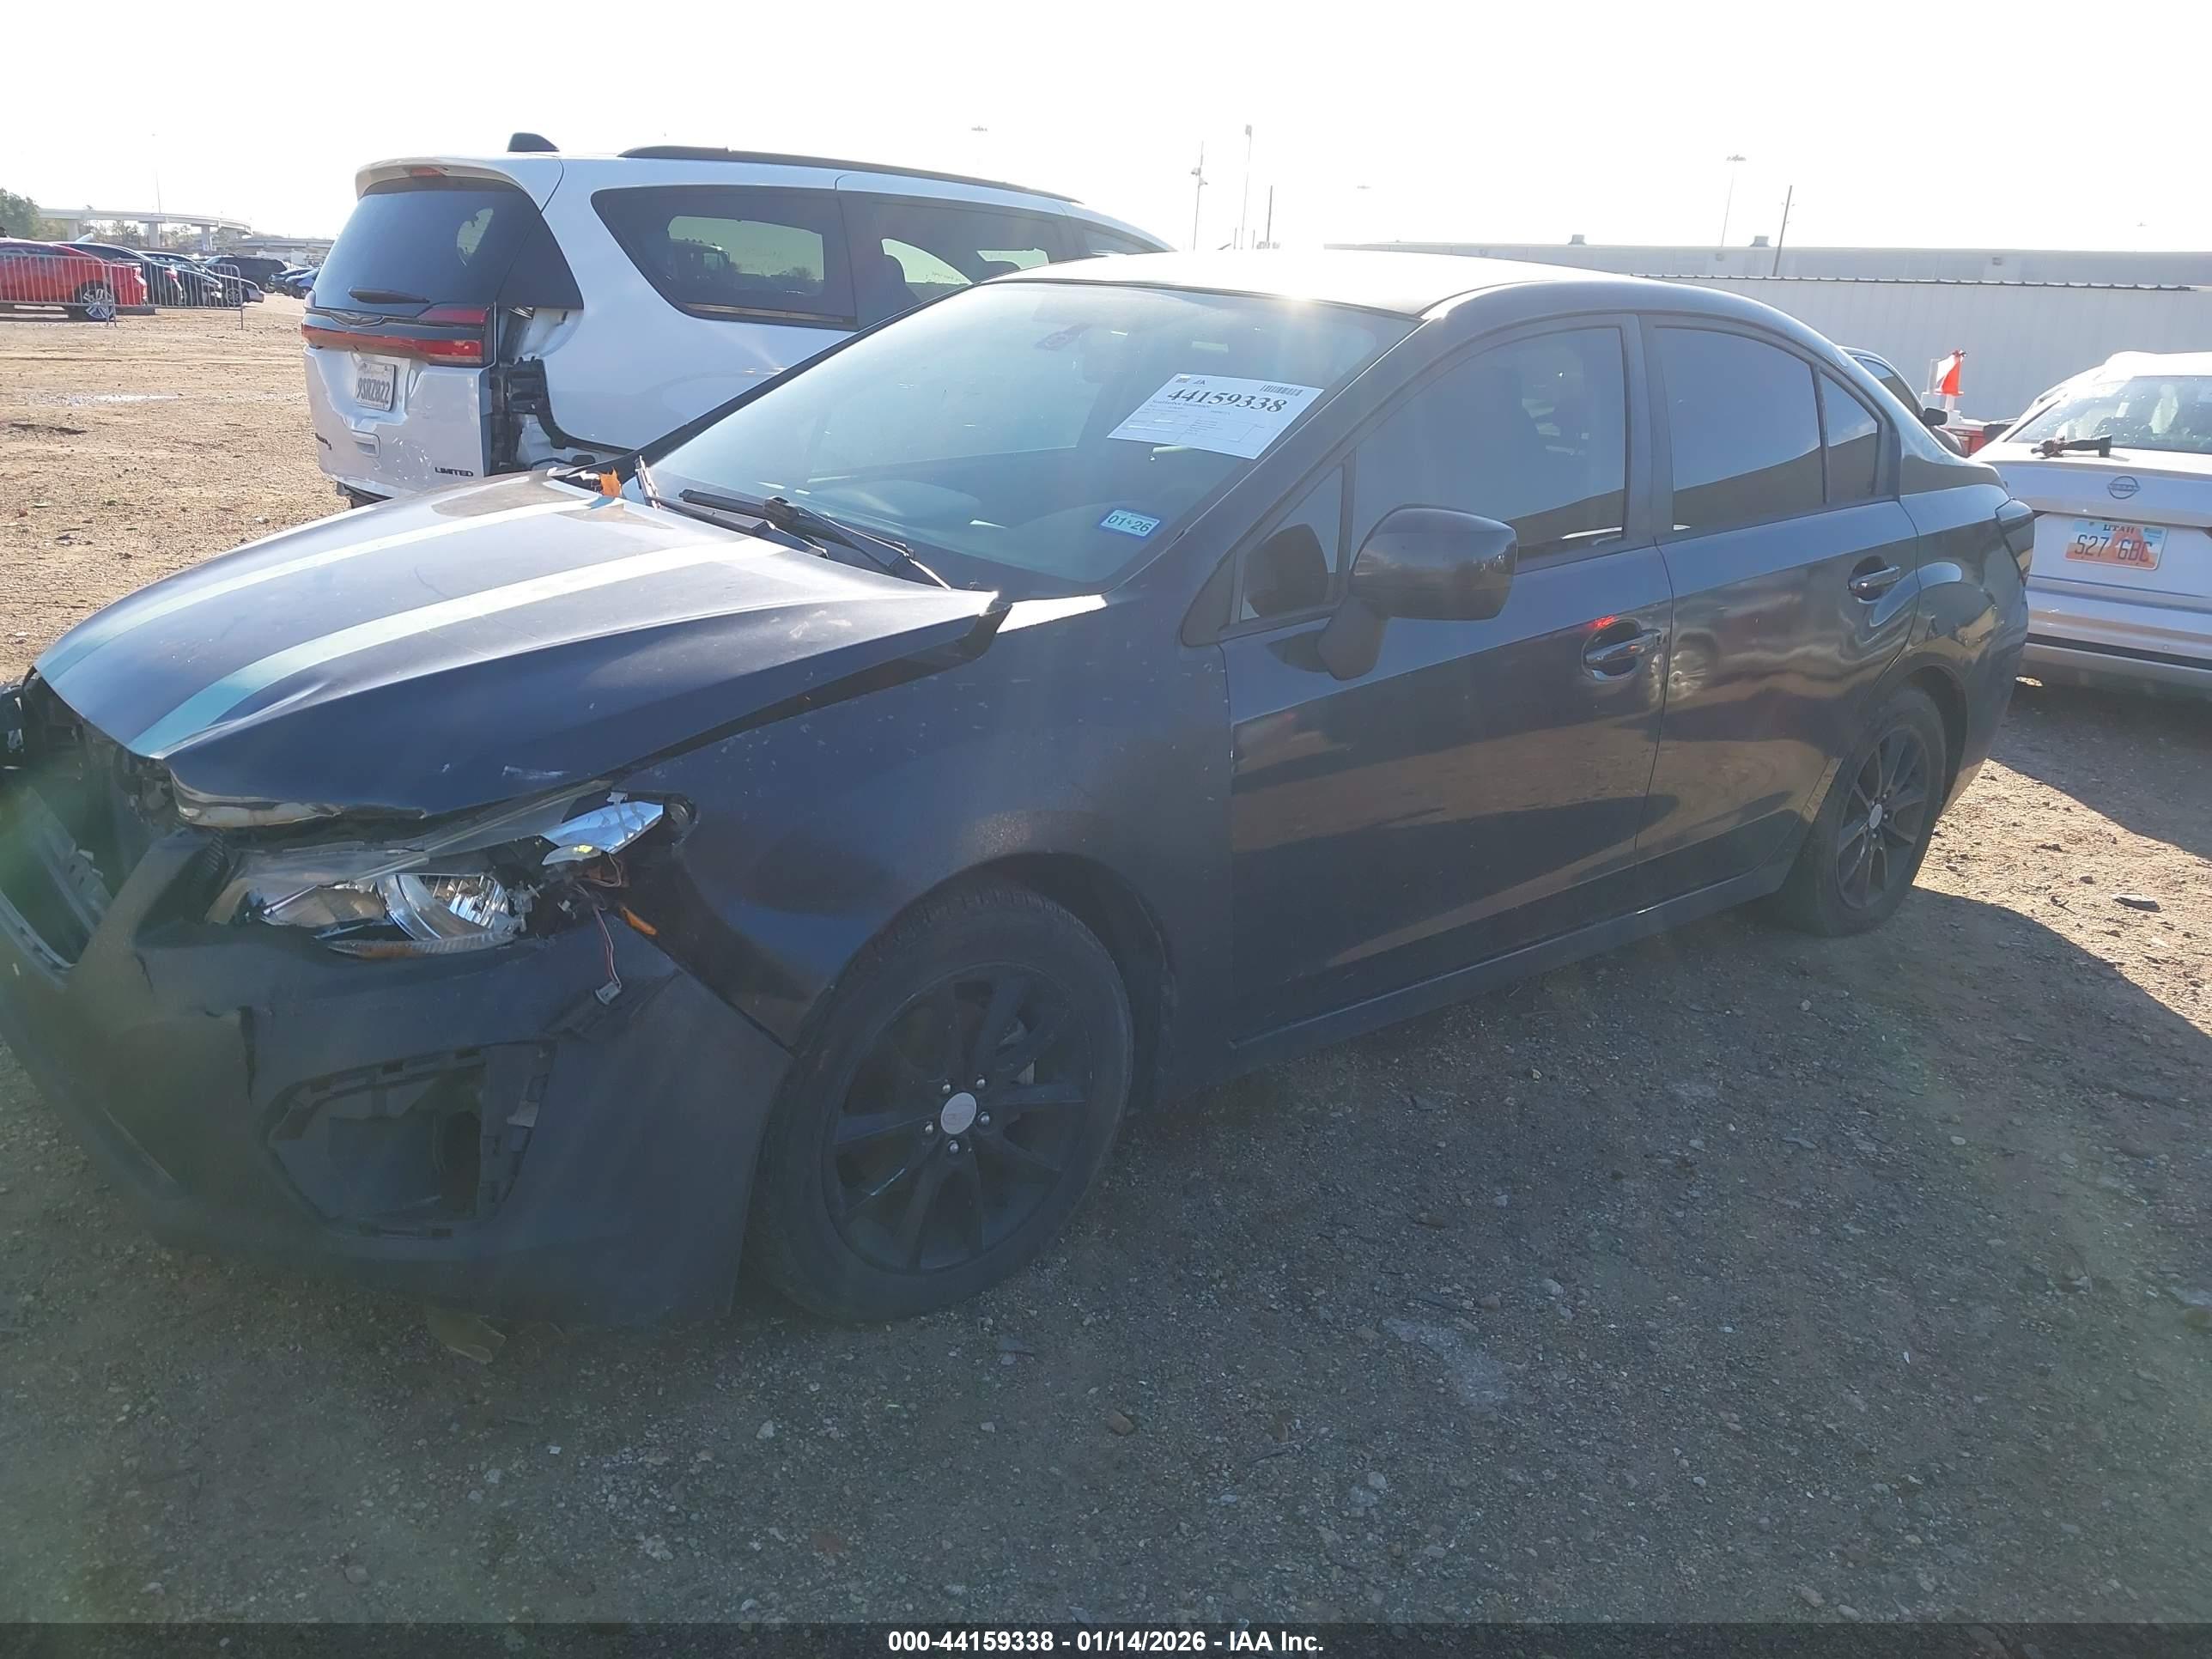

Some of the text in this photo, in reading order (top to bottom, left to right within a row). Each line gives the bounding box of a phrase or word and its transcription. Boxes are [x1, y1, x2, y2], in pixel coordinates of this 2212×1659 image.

[1167, 388, 1288, 413] 44159338
[434, 466, 474, 477] LIMITED
[2102, 524, 2135, 534] UTAH
[2074, 533, 2110, 557] S27
